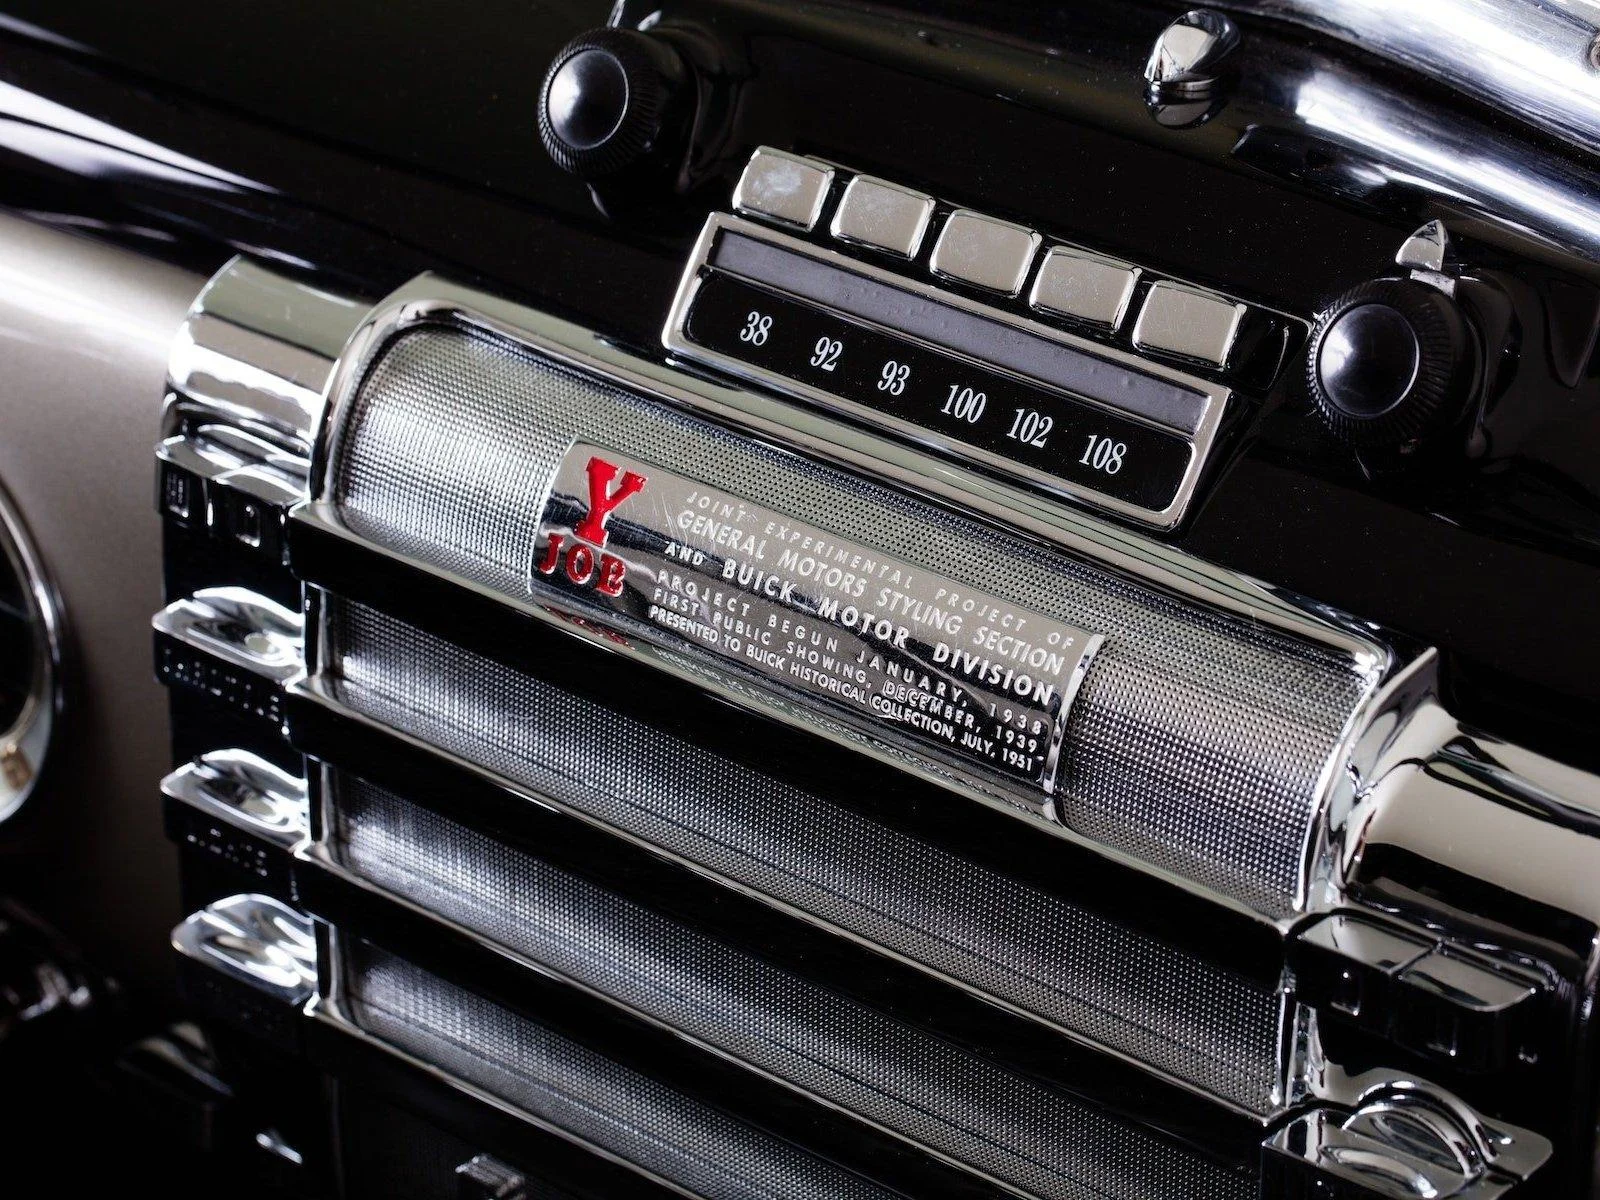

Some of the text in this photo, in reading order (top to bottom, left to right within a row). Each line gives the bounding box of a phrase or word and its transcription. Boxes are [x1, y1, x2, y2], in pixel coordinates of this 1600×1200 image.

[740, 311, 1127, 475] 38 92 93 100 102 108
[539, 534, 627, 597] JOB
[574, 456, 649, 548] Y
[686, 491, 1075, 650] JOINT EXPERIMENTAL PROJECT OF
[653, 587, 1038, 753] FIRST PUBLIC SHOWING, DECEMBER, 1939
[656, 569, 1042, 735] PROJECT BEGUN JANUARY, 1938
[664, 541, 1056, 707] AND BUICK MOTOR DIVISION
[677, 509, 1065, 676] GENERAL MOTORS STYLING SECTION
[648, 604, 1033, 772] PRESENTED TO BUICK HISTORICAL COLLECTION, JULY, 1951
